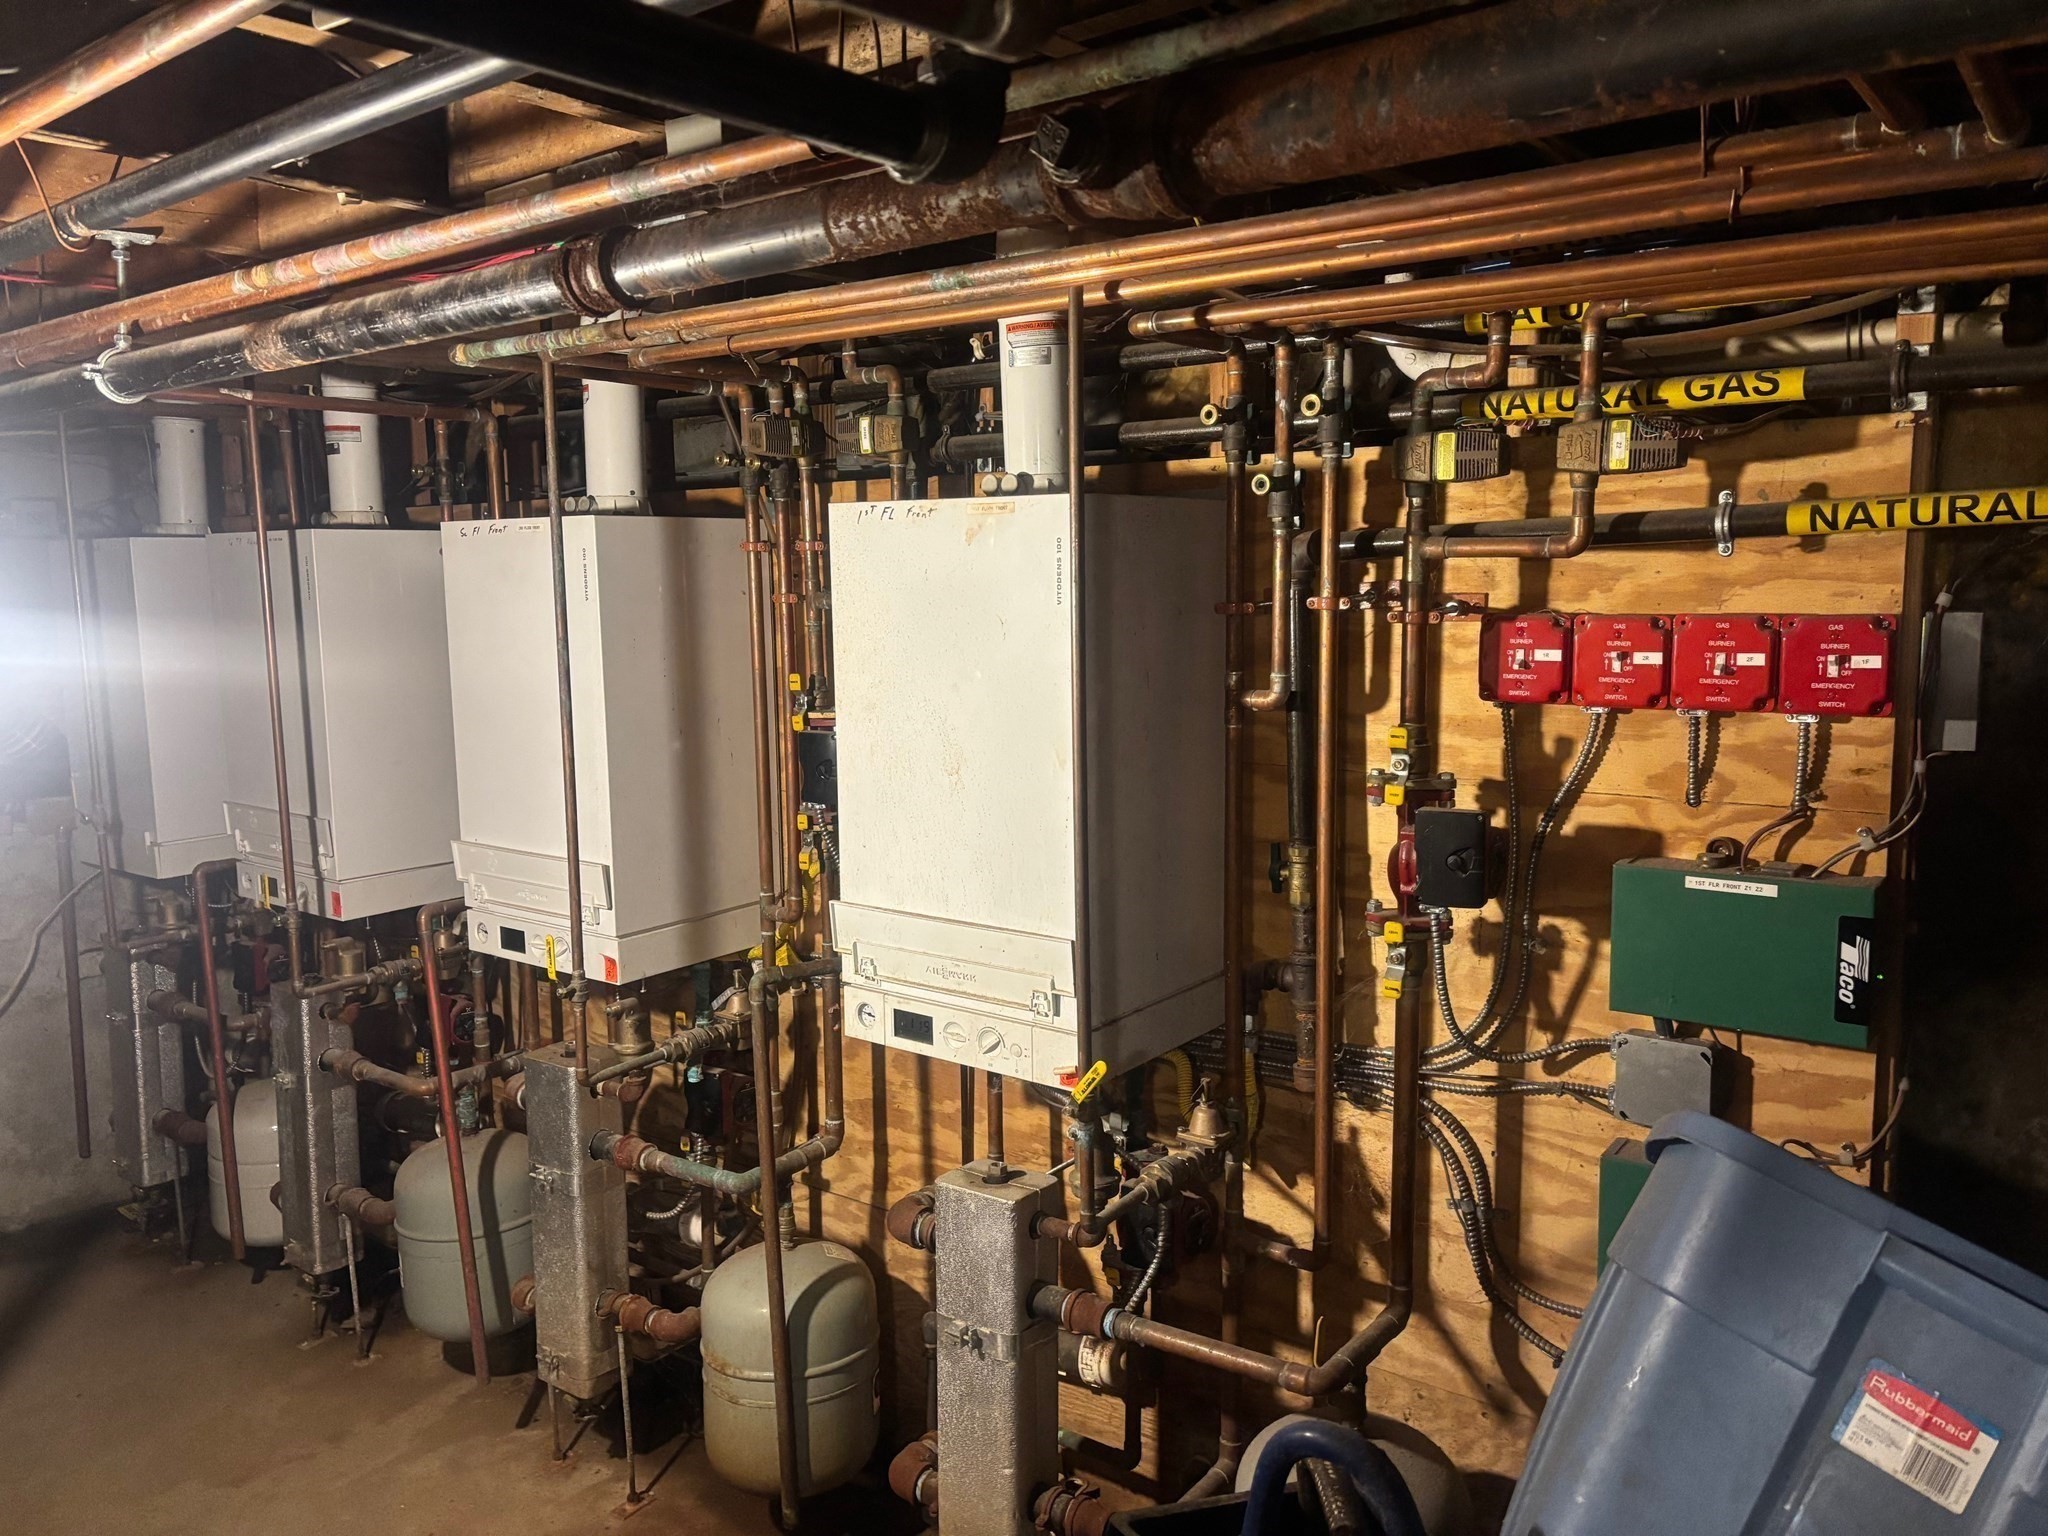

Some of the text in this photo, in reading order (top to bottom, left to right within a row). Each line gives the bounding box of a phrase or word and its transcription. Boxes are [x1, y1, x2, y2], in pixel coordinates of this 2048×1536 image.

[1684, 368, 1781, 401] GAS
[880, 506, 895, 520] FL
[1809, 490, 2048, 532] NATURAL
[1502, 673, 1538, 681] EMERGENCY
[1598, 677, 1636, 685] EMERGENCY
[1818, 701, 1846, 709] SWITCH
[1722, 883, 1742, 891] FRONT
[1838, 934, 1871, 1005] Taco
[1869, 1375, 1972, 1442] Rubbermaid
